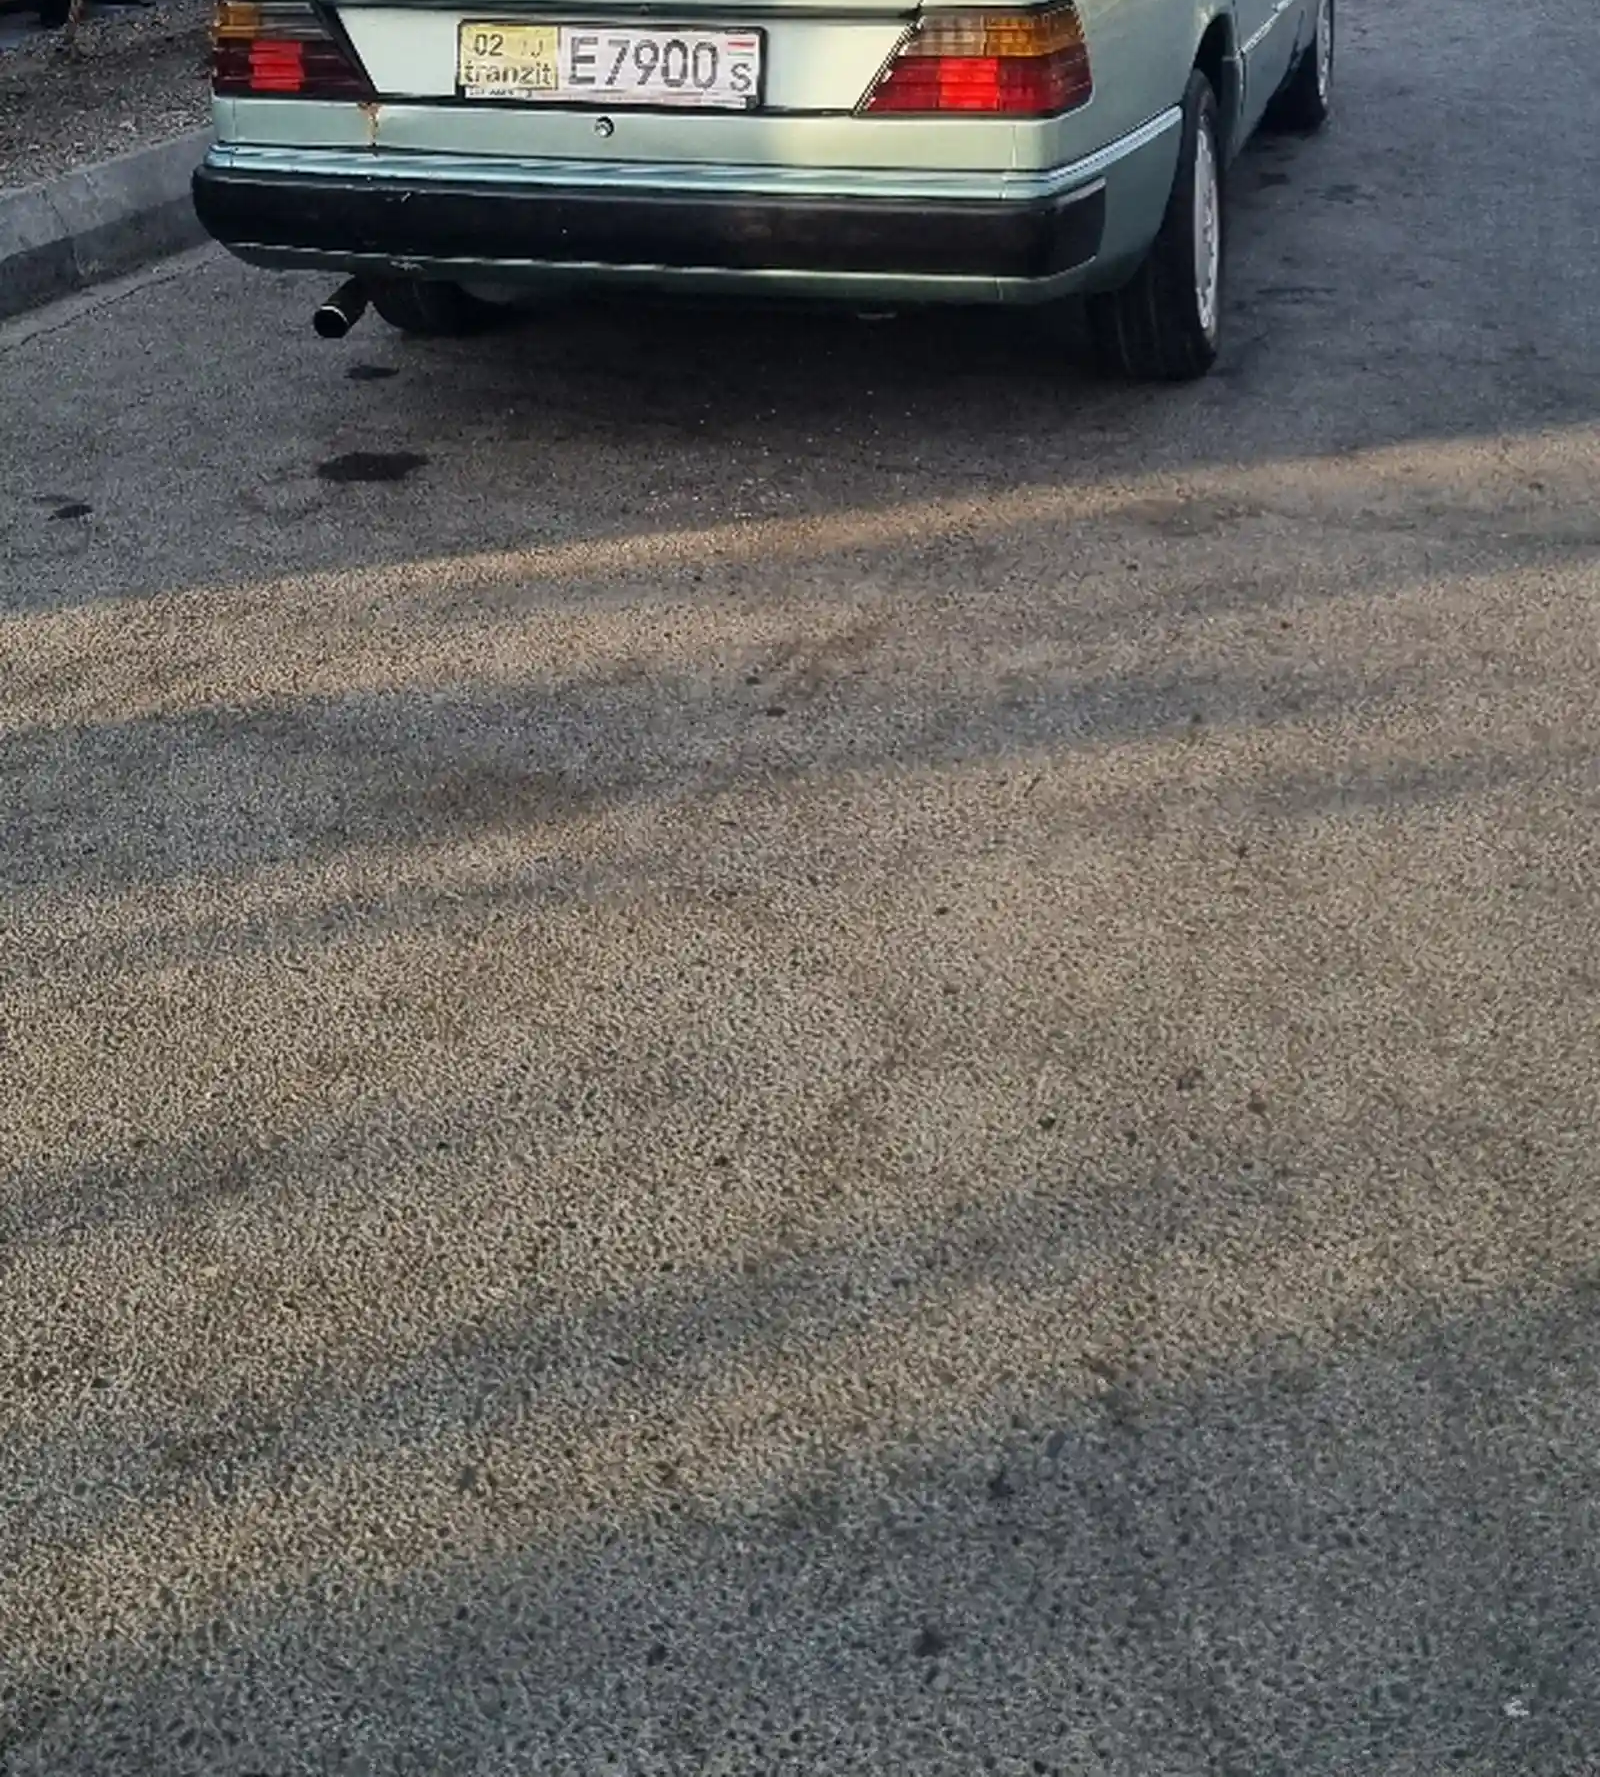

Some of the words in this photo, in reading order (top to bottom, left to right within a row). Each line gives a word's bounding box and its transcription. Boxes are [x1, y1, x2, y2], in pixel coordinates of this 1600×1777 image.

[474, 33, 503, 57] 02
[464, 61, 552, 87] tranzit
[568, 36, 719, 90] E7900
